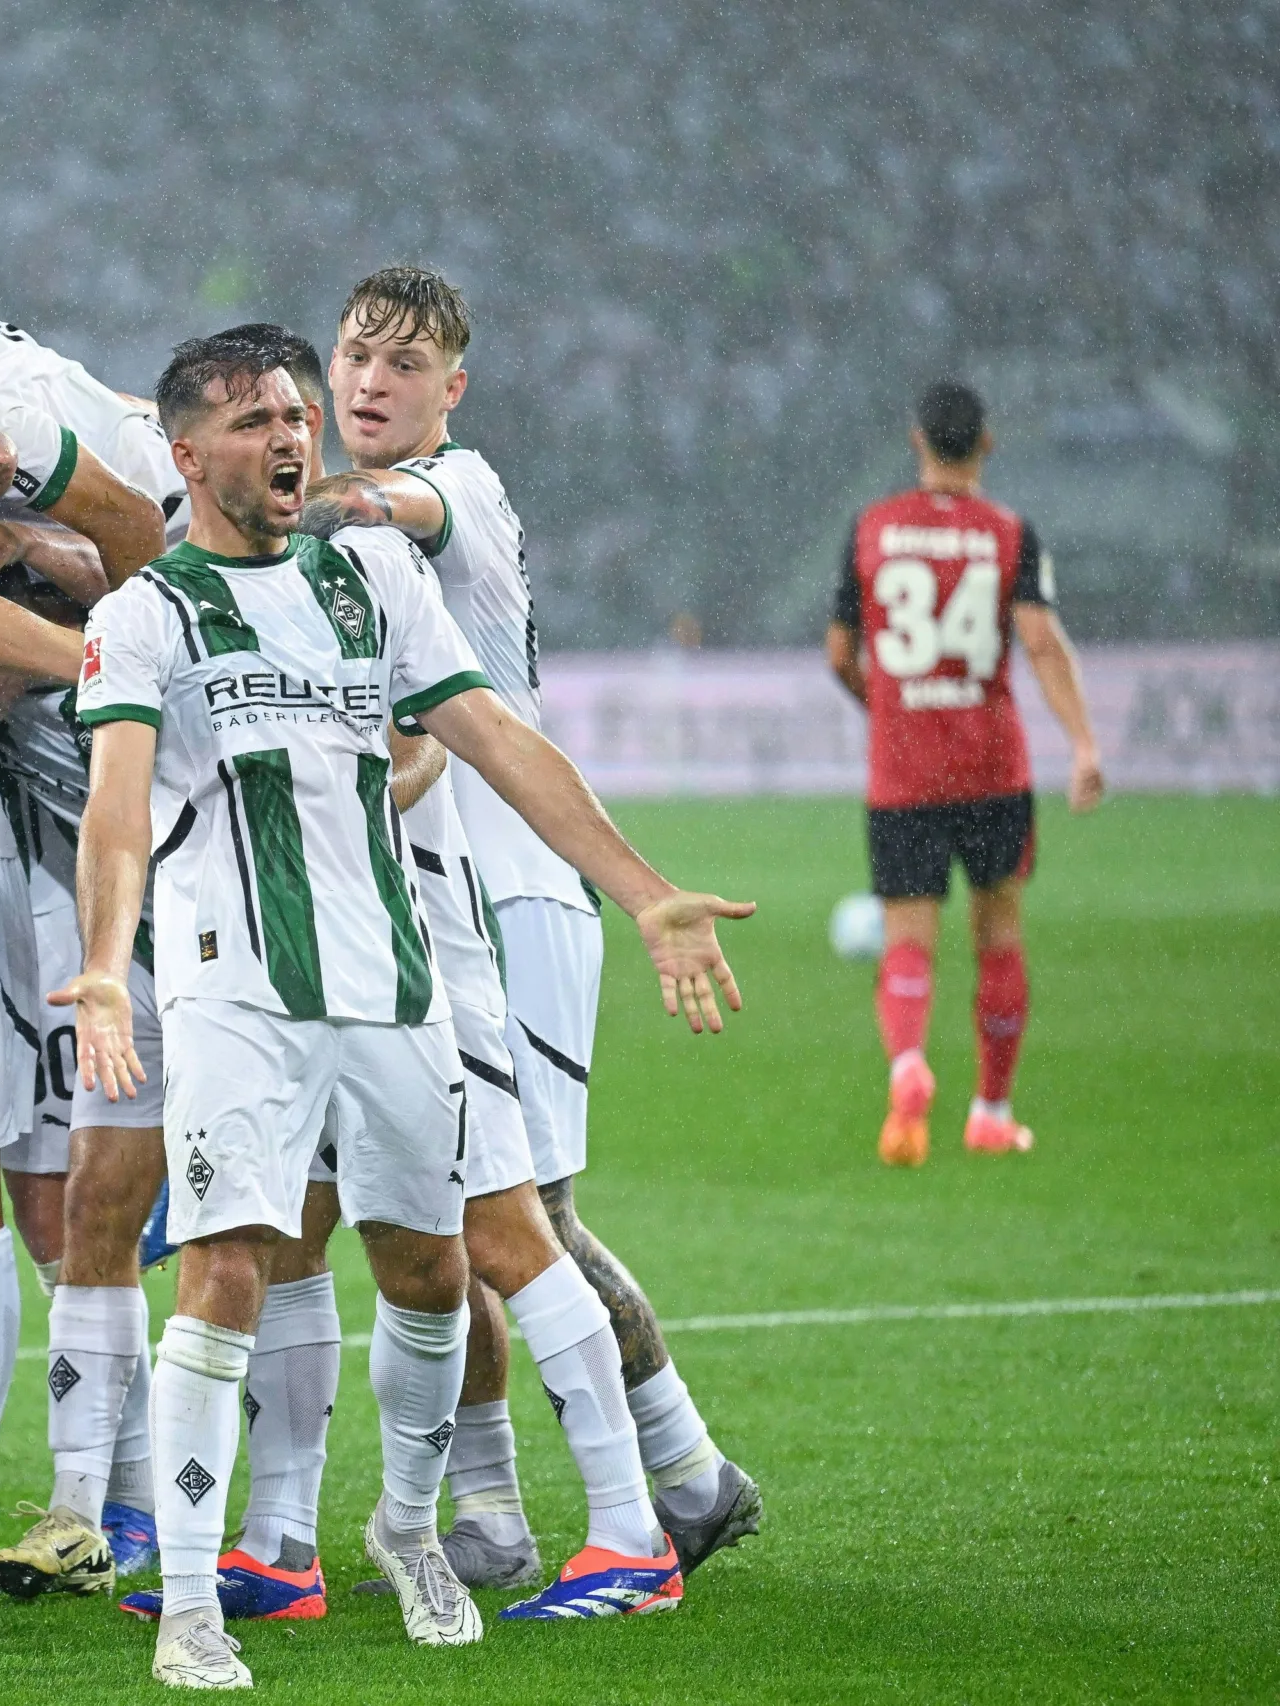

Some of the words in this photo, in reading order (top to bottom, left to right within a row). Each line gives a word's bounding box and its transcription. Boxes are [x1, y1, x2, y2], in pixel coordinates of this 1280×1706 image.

[874, 557, 1001, 681] 34
[213, 711, 287, 732] BÄDER
[307, 713, 380, 736] LEUCTE
